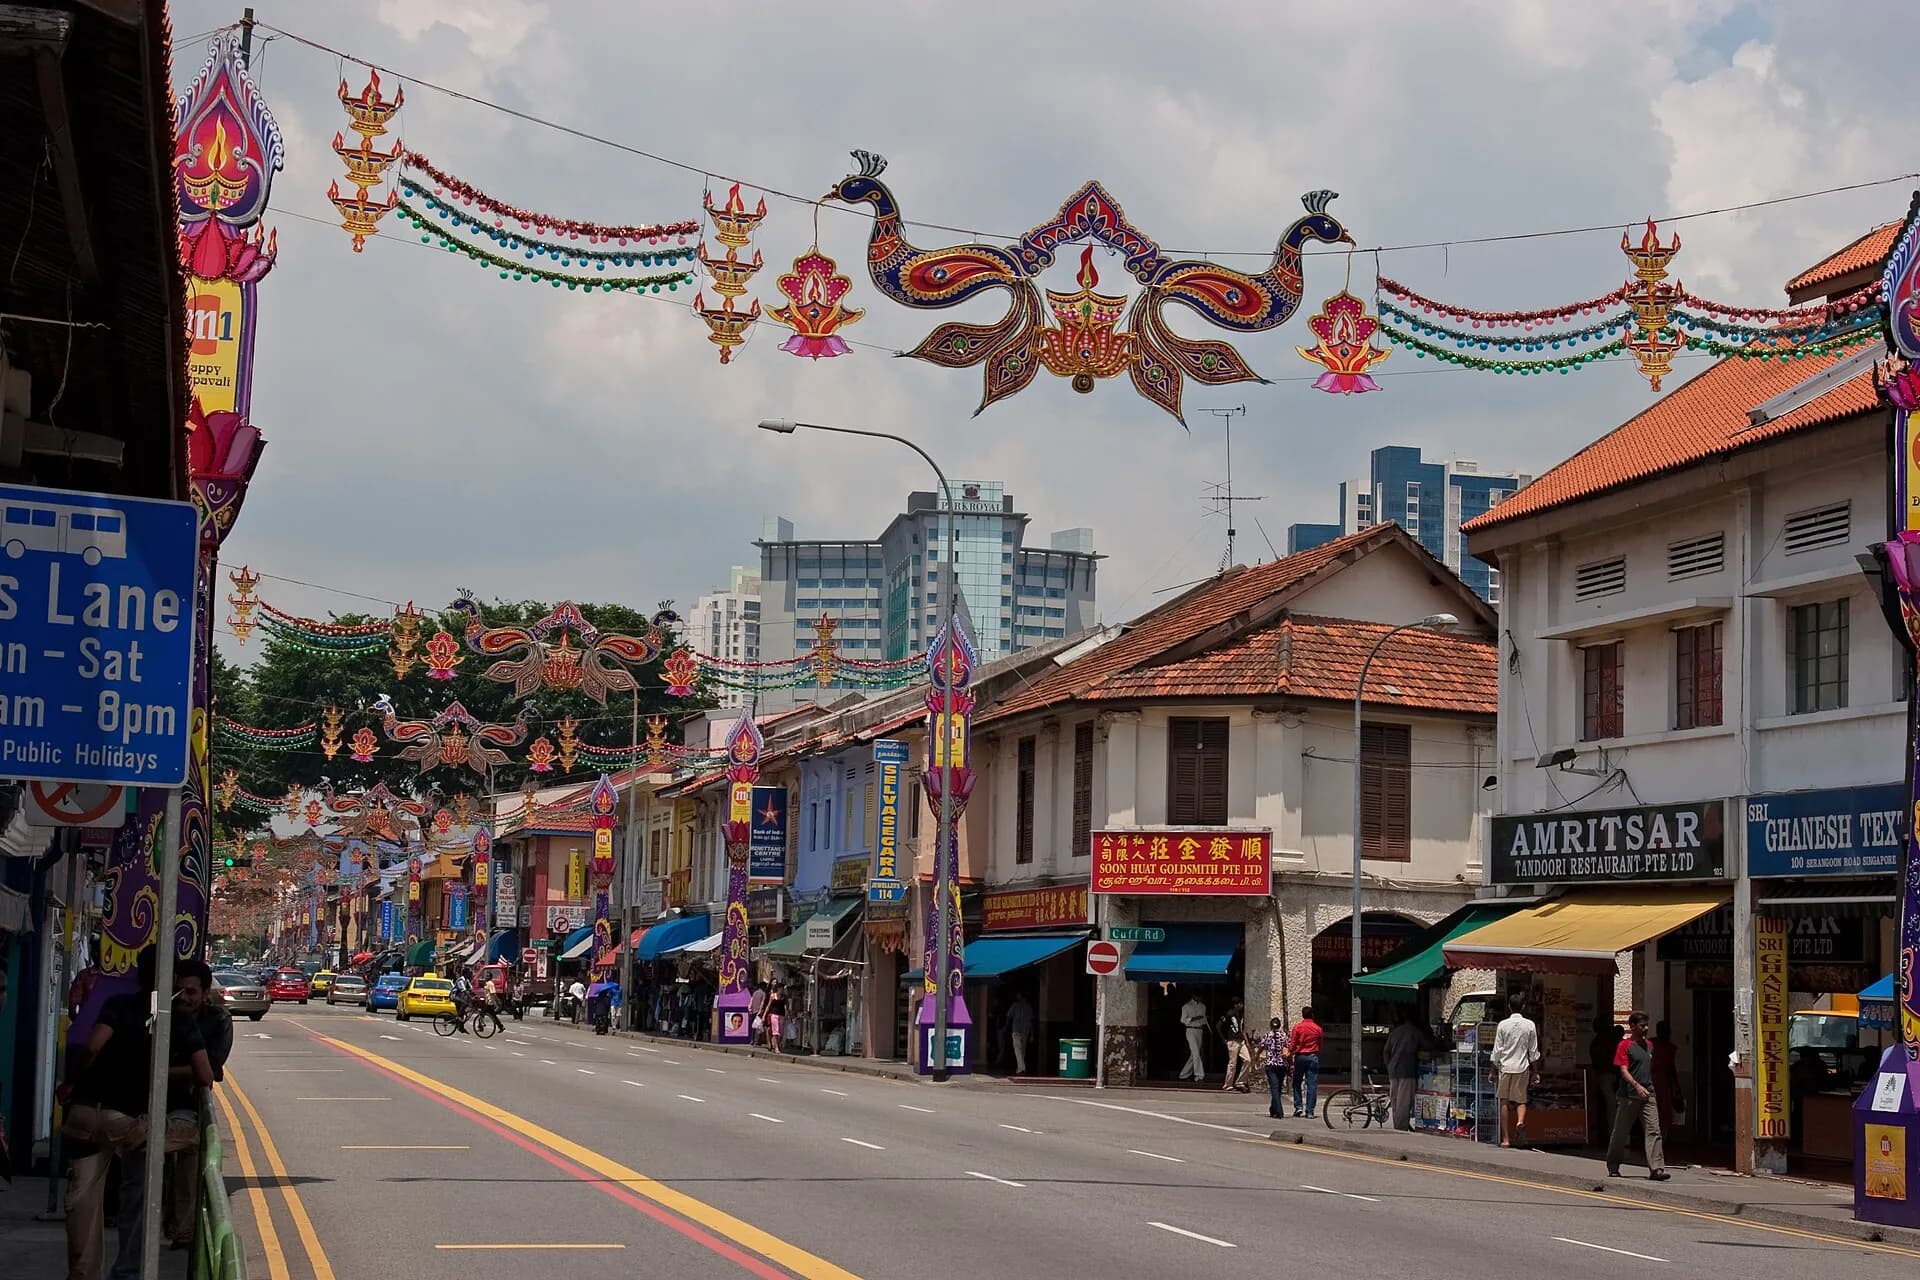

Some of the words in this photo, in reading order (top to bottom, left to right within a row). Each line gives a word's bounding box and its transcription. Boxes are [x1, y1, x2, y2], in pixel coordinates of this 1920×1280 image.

[191, 364, 222, 375] appy
[941, 501, 1003, 513] PRKROYAL
[48, 562, 180, 633] Lane
[79, 637, 144, 683] Sat
[98, 689, 176, 744] 8pm
[4, 739, 62, 764] Public
[76, 743, 158, 774] Holidays
[879, 765, 897, 877] SELVASEGARA
[1748, 803, 1769, 822] SRI
[1510, 812, 1701, 856] AMRITSAR
[1765, 814, 1852, 852] GHANESH
[1099, 863, 1127, 875] SOON
[1130, 863, 1157, 875] HUAT
[1160, 863, 1218, 875] GOLDSMITH
[1222, 864, 1241, 875] PTE
[1244, 864, 1263, 875] LTD
[1515, 858, 1567, 877] TANDOORI
[1570, 855, 1641, 876] RESTAURANT
[1645, 853, 1667, 873] PTE
[1672, 852, 1694, 872] LTD
[1791, 857, 1804, 869] 100
[1806, 857, 1842, 868] SERANGOON
[1844, 856, 1861, 867] ROAD
[1862, 855, 1896, 866] SINGAPORE
[879, 889, 893, 899] 114
[1112, 928, 1139, 940] Cuff
[1145, 929, 1160, 940] Rd
[1759, 916, 1784, 933] 100
[1759, 938, 1783, 950] SRI
[1760, 953, 1783, 1024] GHANESH
[1761, 1031, 1783, 1114] TEXTILES
[1760, 1118, 1786, 1137] 100
